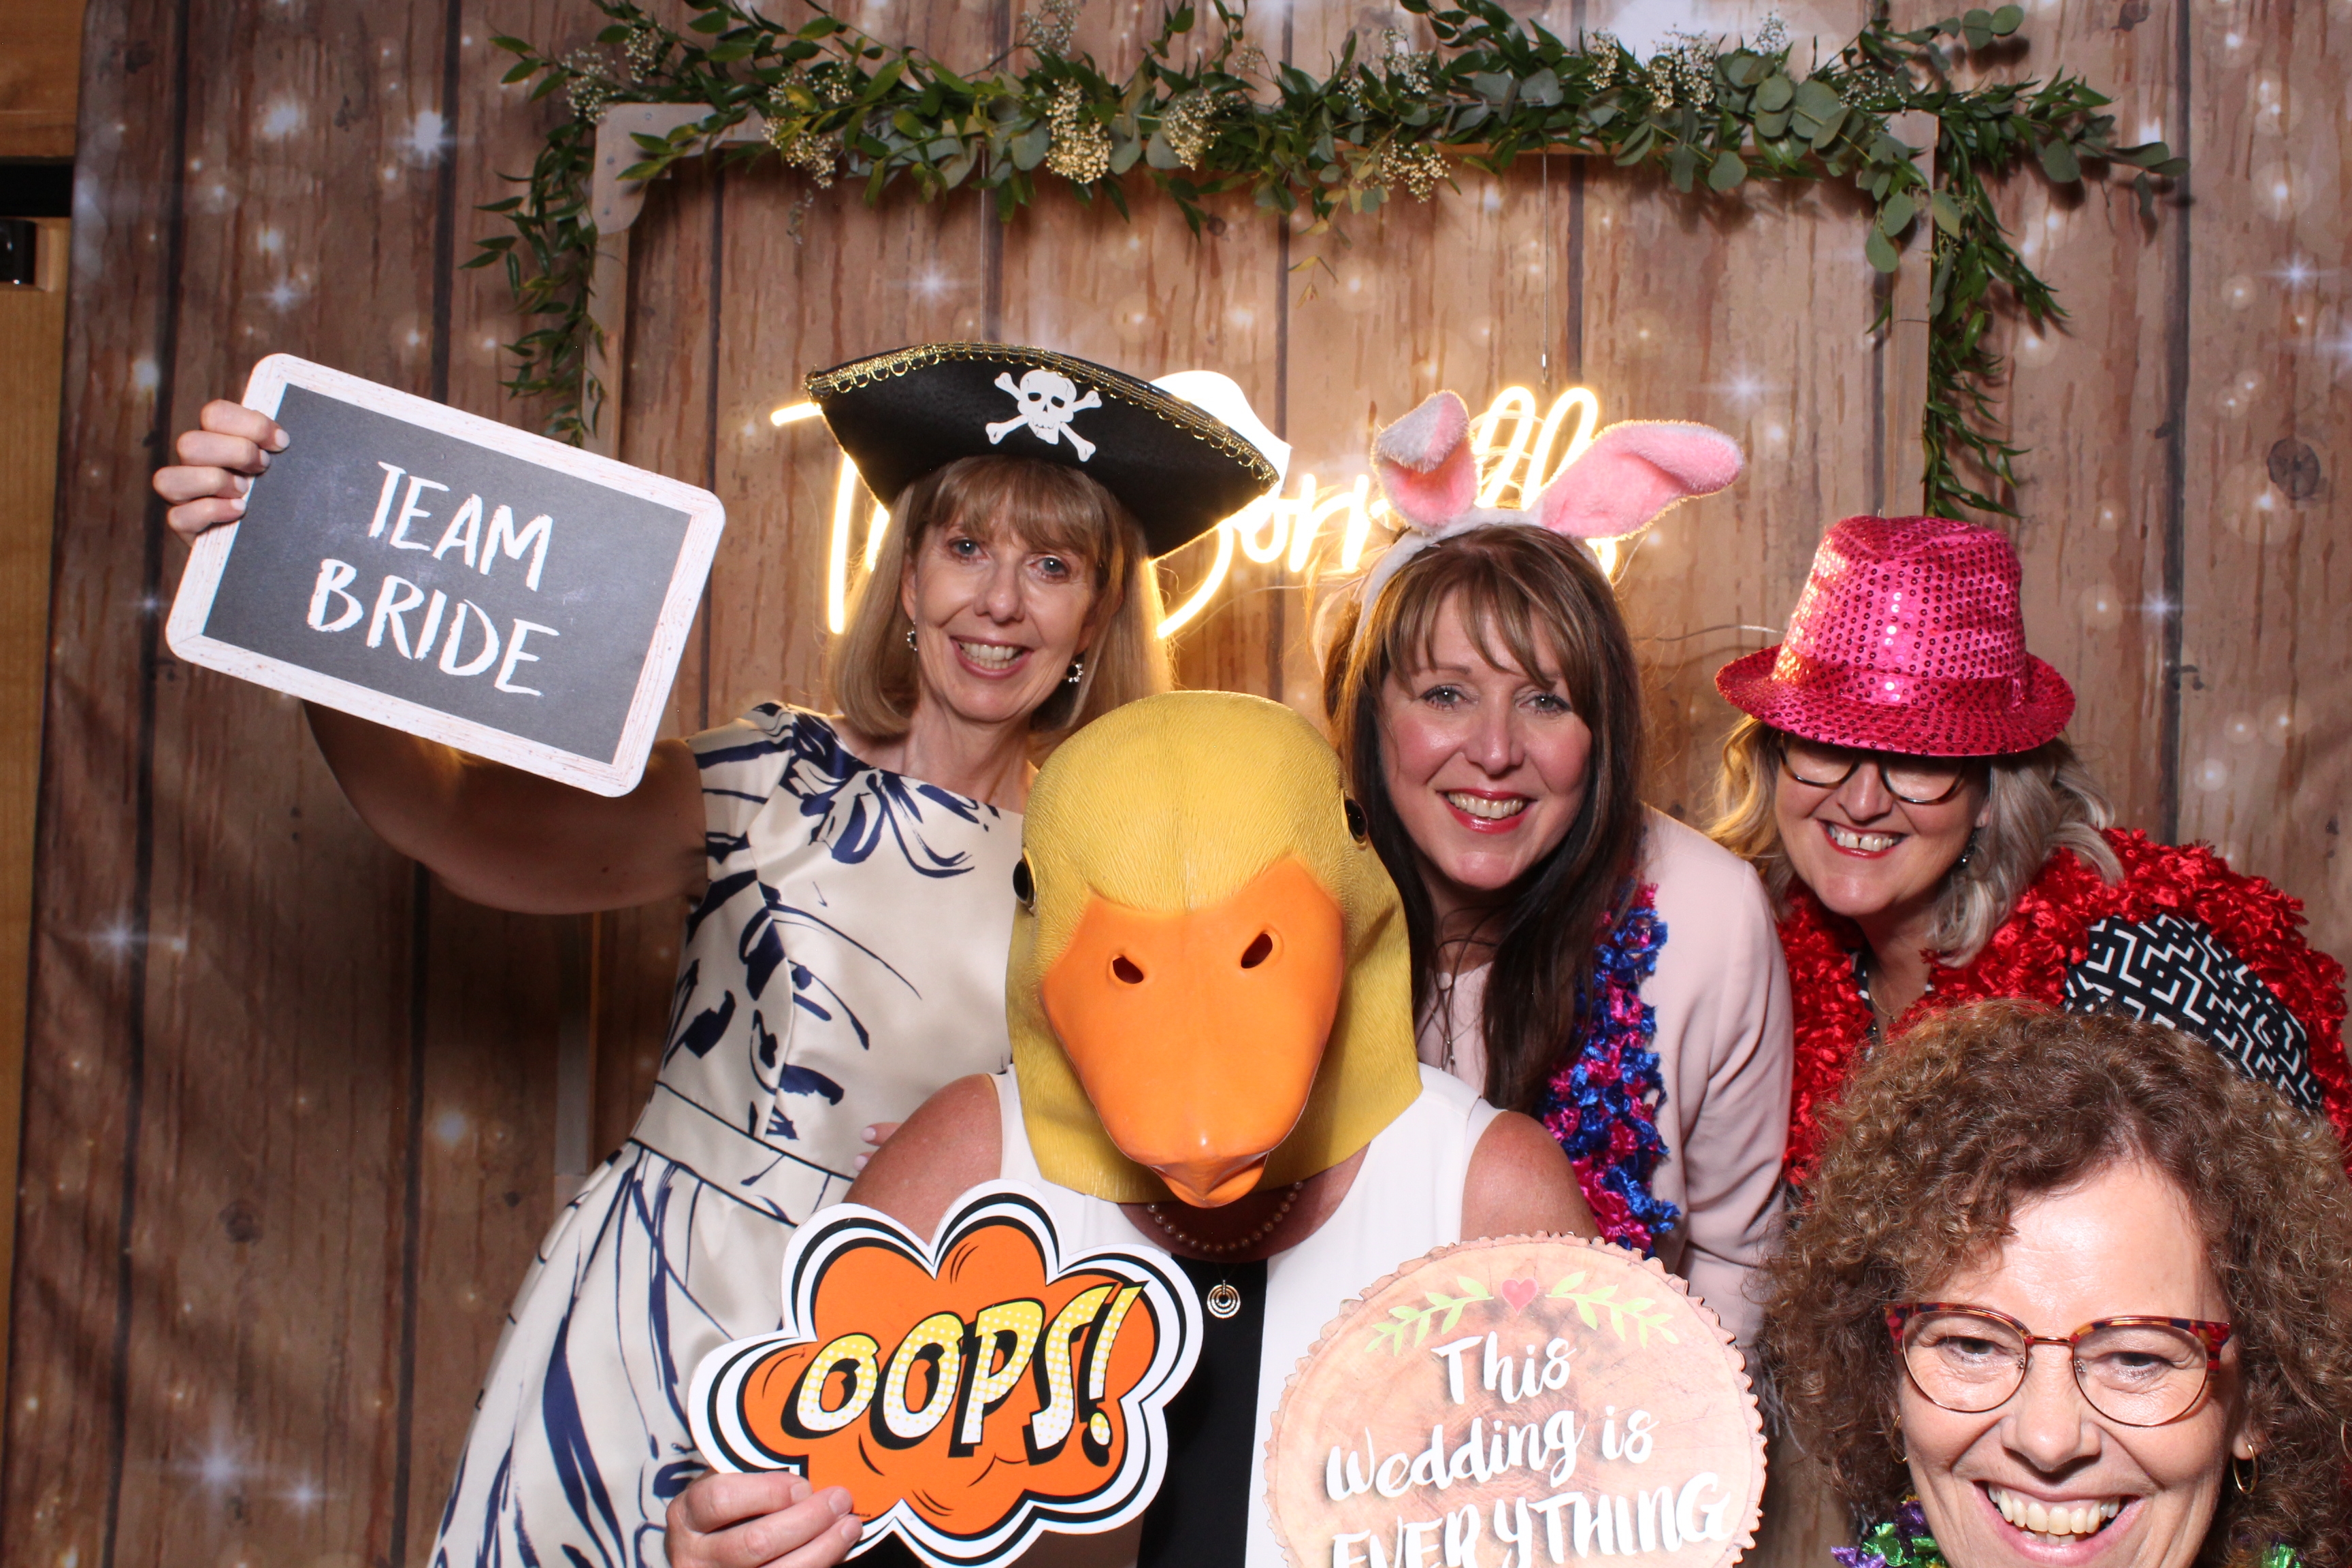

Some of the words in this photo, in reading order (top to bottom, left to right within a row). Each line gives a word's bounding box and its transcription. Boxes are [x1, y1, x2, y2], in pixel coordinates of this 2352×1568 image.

[368, 461, 553, 591] TEAM
[307, 558, 560, 696] BRIDE
[781, 1280, 1150, 1466] OOPS!
[1431, 1330, 1577, 1405] This
[1326, 1409, 1585, 1502] Wedding
[1602, 1405, 1660, 1464] is
